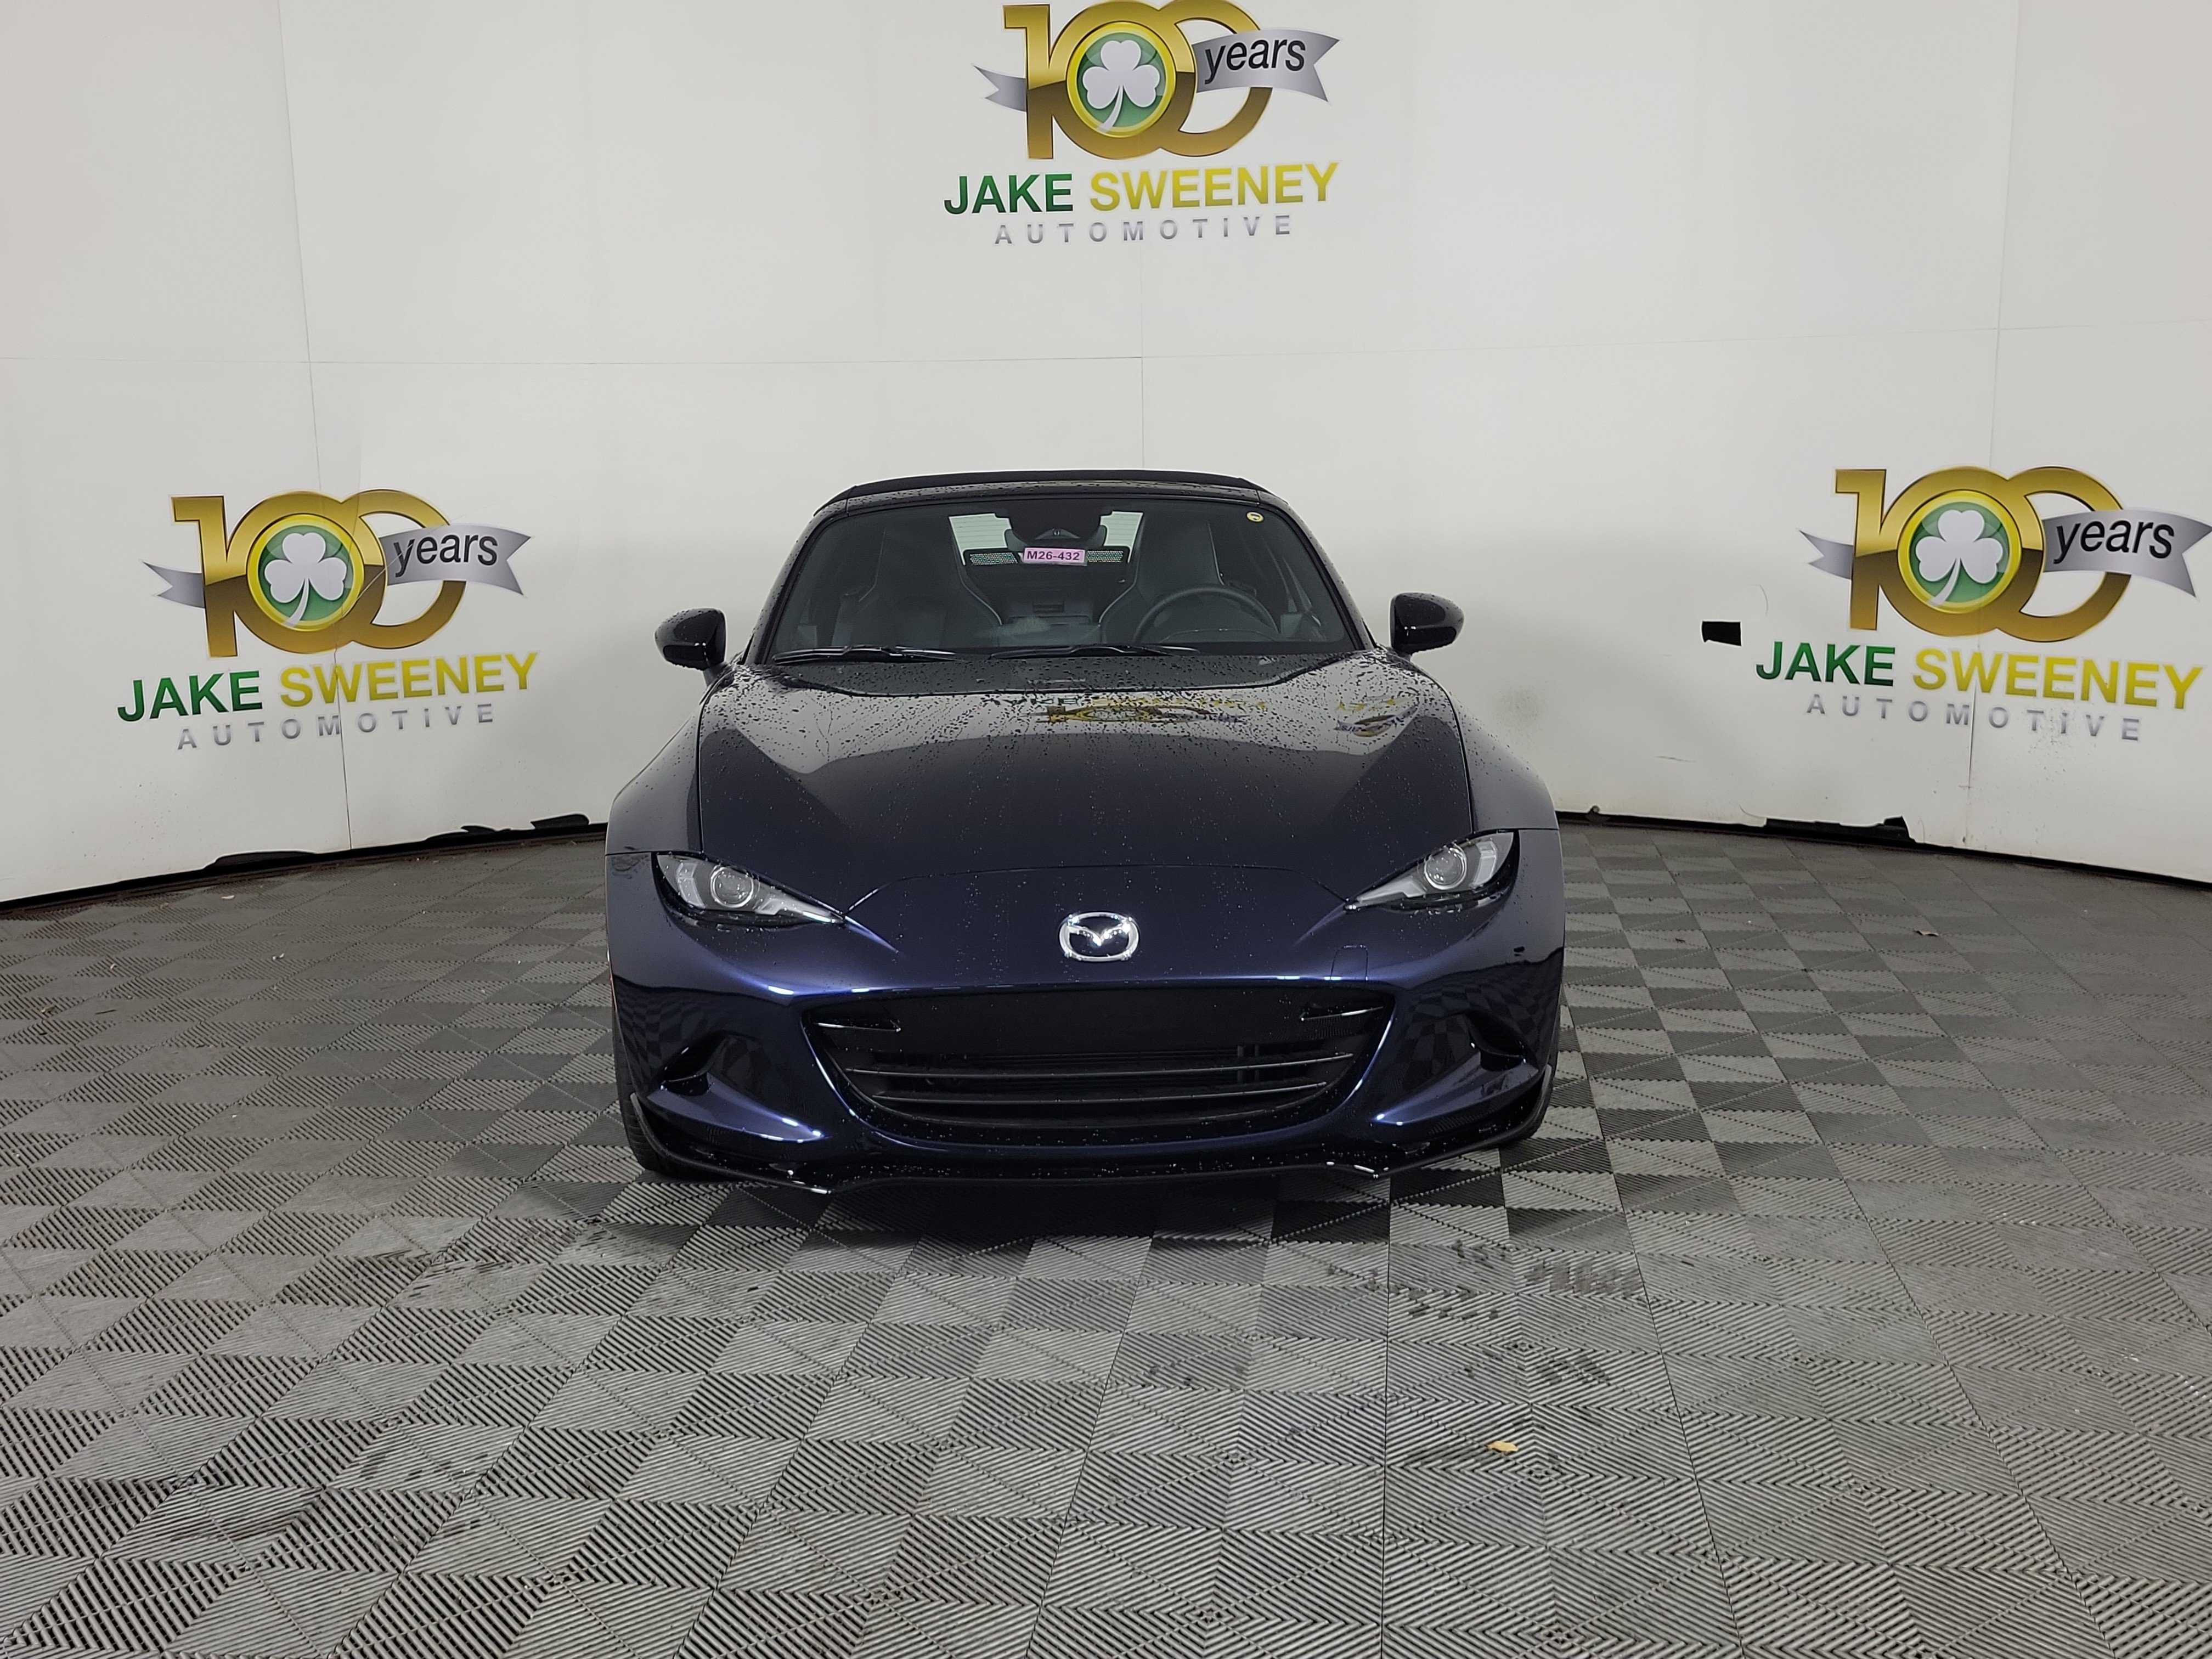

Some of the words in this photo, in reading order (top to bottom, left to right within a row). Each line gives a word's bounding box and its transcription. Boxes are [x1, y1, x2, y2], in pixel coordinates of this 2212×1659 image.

[1005, 0, 1273, 160] 100
[1205, 37, 1306, 84] years
[944, 174, 1073, 214] JAKE
[1090, 162, 1338, 211] SWEENEY
[995, 215, 1290, 244] AUTOMOTIVE
[171, 489, 466, 657] 100
[393, 534, 498, 578] years
[1027, 550, 1080, 561] M26-432
[1836, 465, 2131, 642] 100
[2053, 520, 2174, 564] years
[117, 671, 262, 721] JAKE
[280, 653, 537, 707] SWEENEY
[1757, 641, 1895, 686] JAKE
[1913, 648, 2202, 709] SWEENEY
[177, 703, 493, 750] AUTOMOTIVE
[1807, 694, 2139, 741] AUTOMOTIVE
